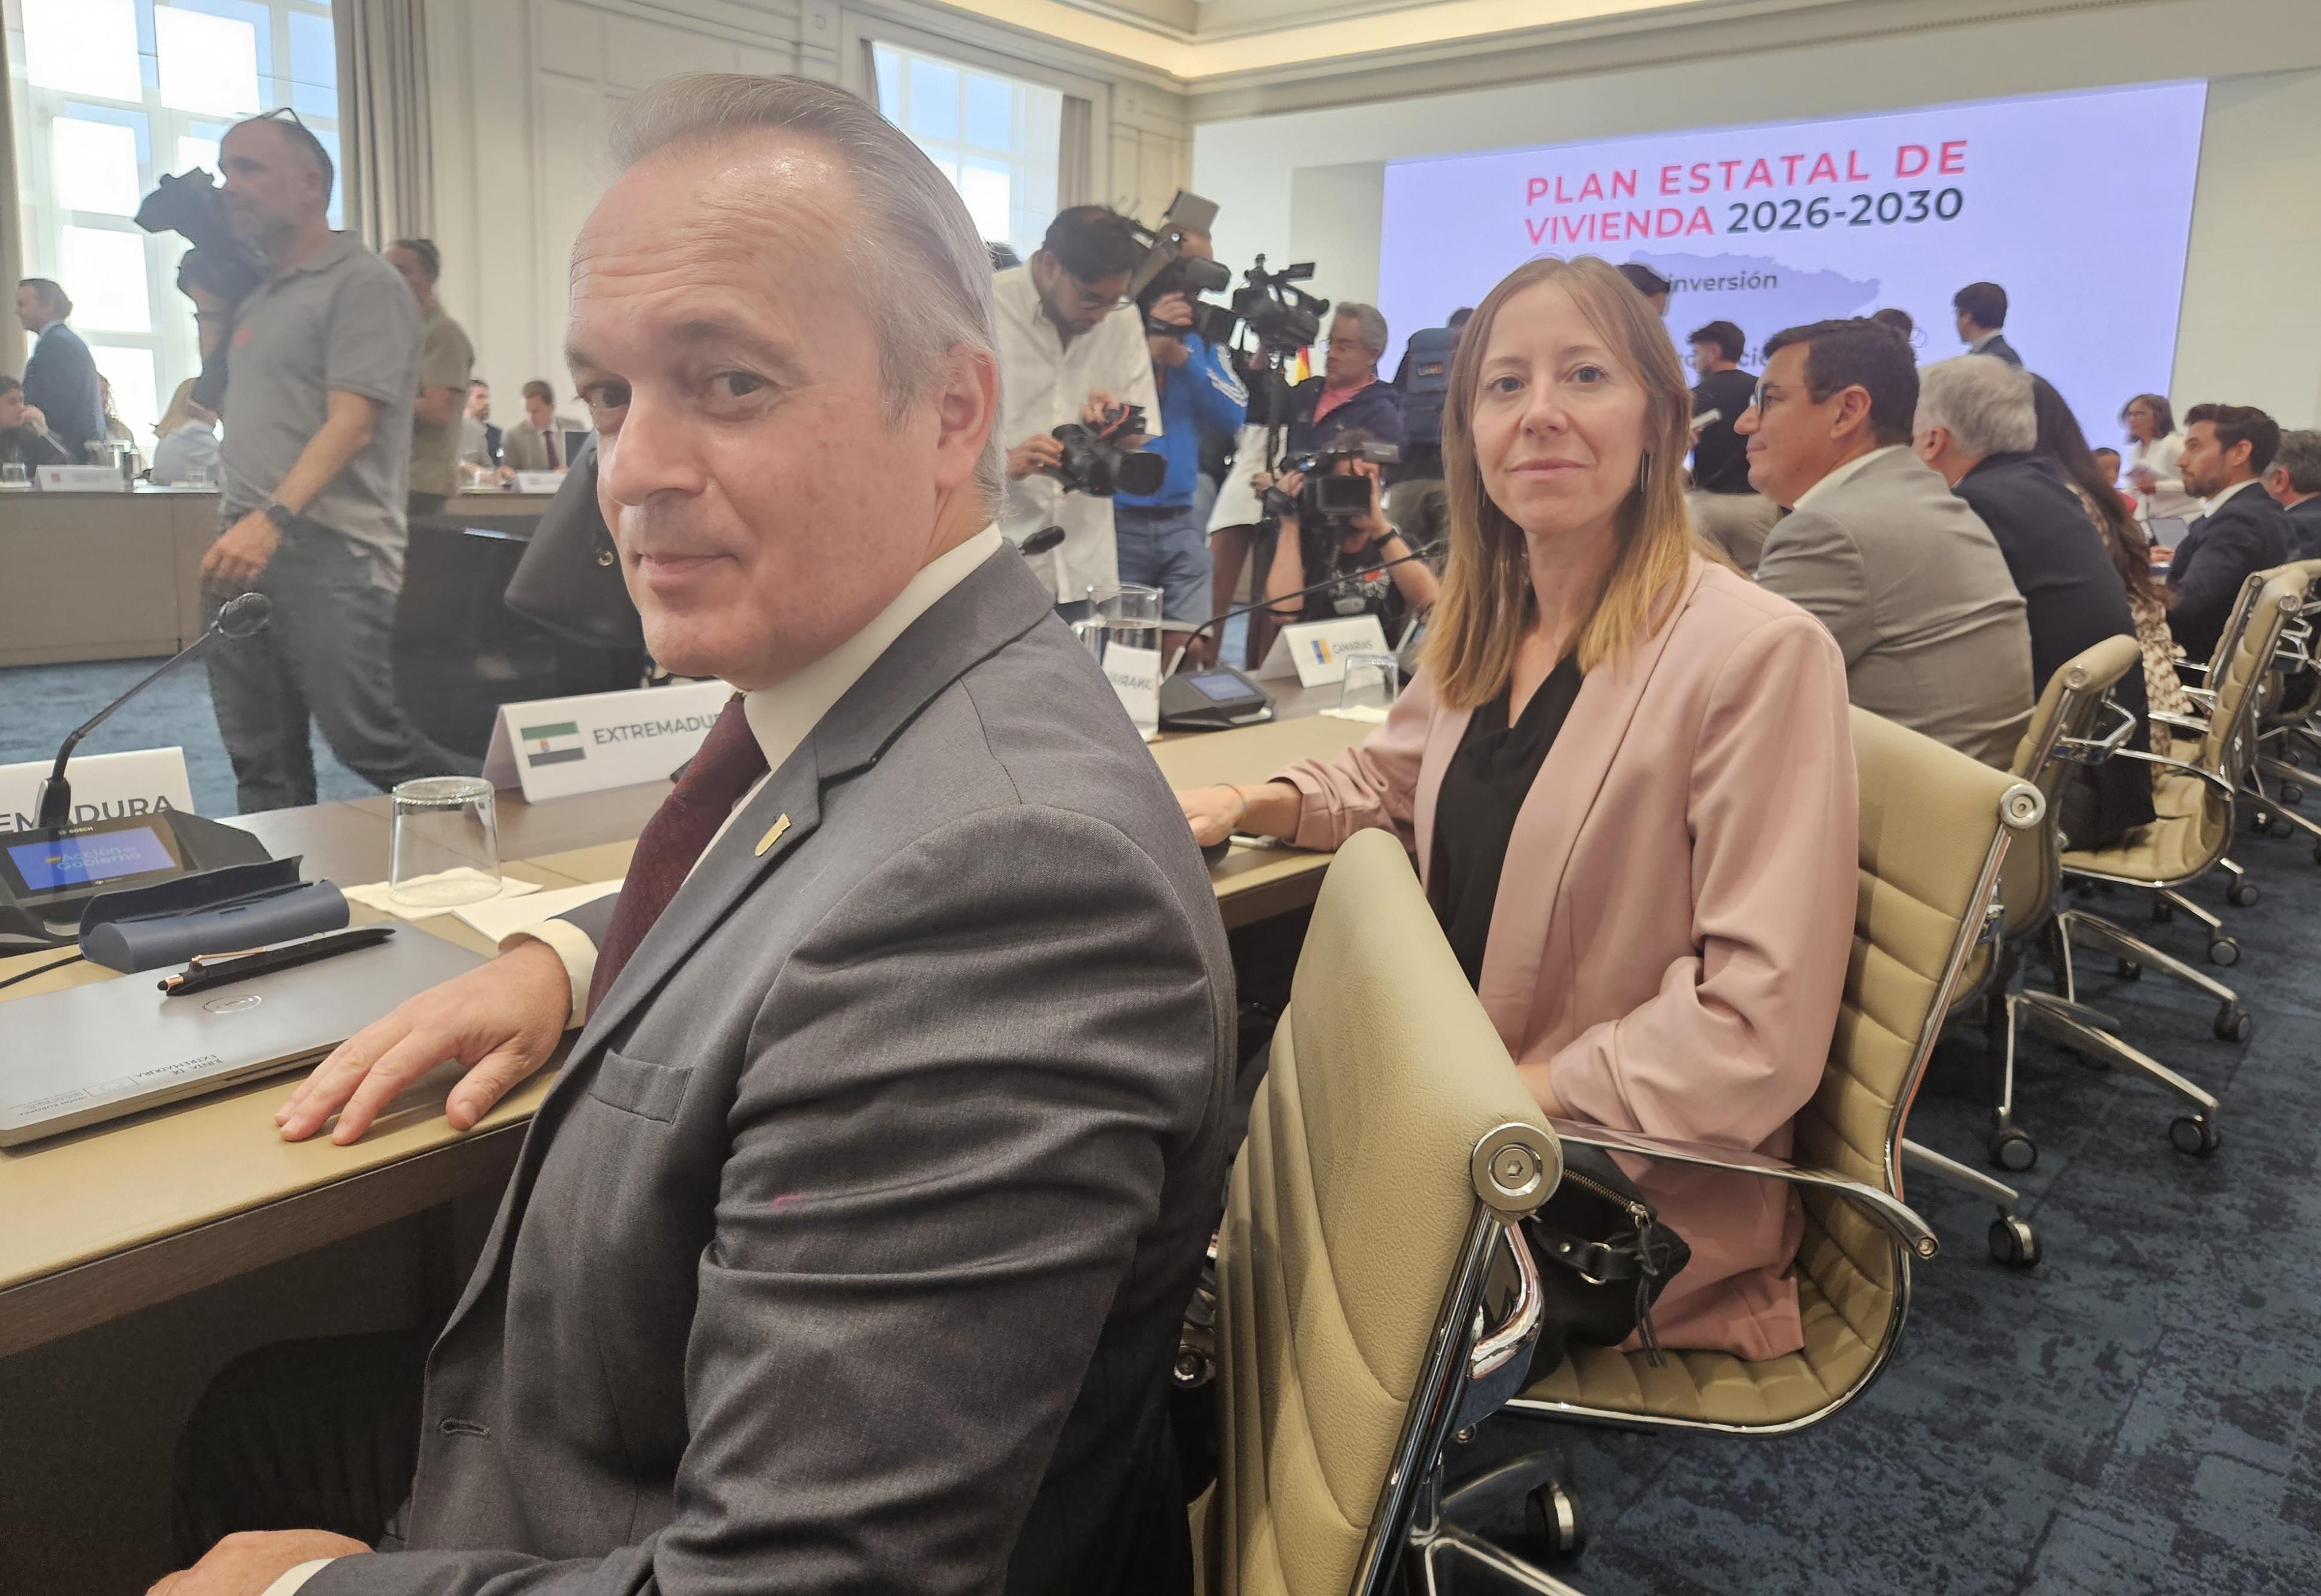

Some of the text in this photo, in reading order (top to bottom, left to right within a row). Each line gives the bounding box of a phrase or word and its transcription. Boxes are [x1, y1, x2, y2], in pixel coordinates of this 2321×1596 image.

[1526, 140, 1968, 206] PLAN ESTATAL DE
[1524, 187, 1963, 245] VIVIENDA 2026-2030
[1669, 270, 1778, 293] inversión
[1332, 639, 1373, 654] CANARIAS
[0, 795, 176, 832] EMDURA
[57, 852, 141, 871] Gobierno
[62, 847, 121, 862] Acción
